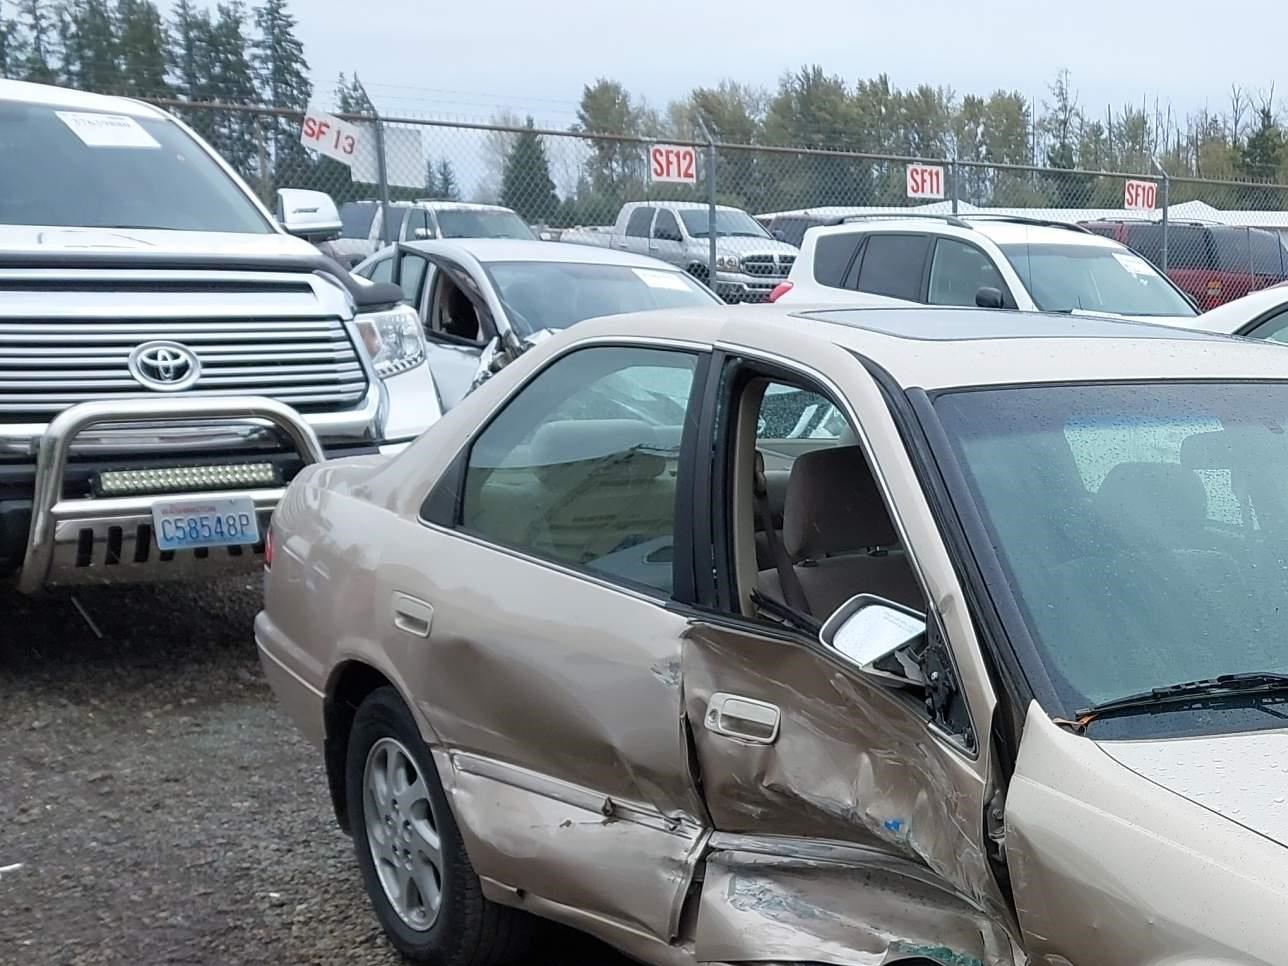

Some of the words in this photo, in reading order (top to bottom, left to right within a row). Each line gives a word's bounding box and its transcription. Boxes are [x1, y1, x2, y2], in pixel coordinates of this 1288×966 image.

[303, 117, 330, 140] SF
[333, 129, 355, 155] 13
[652, 148, 694, 178] SF12
[910, 167, 940, 194] SF11
[1126, 182, 1155, 208] SF10
[162, 513, 250, 542] C58548P
